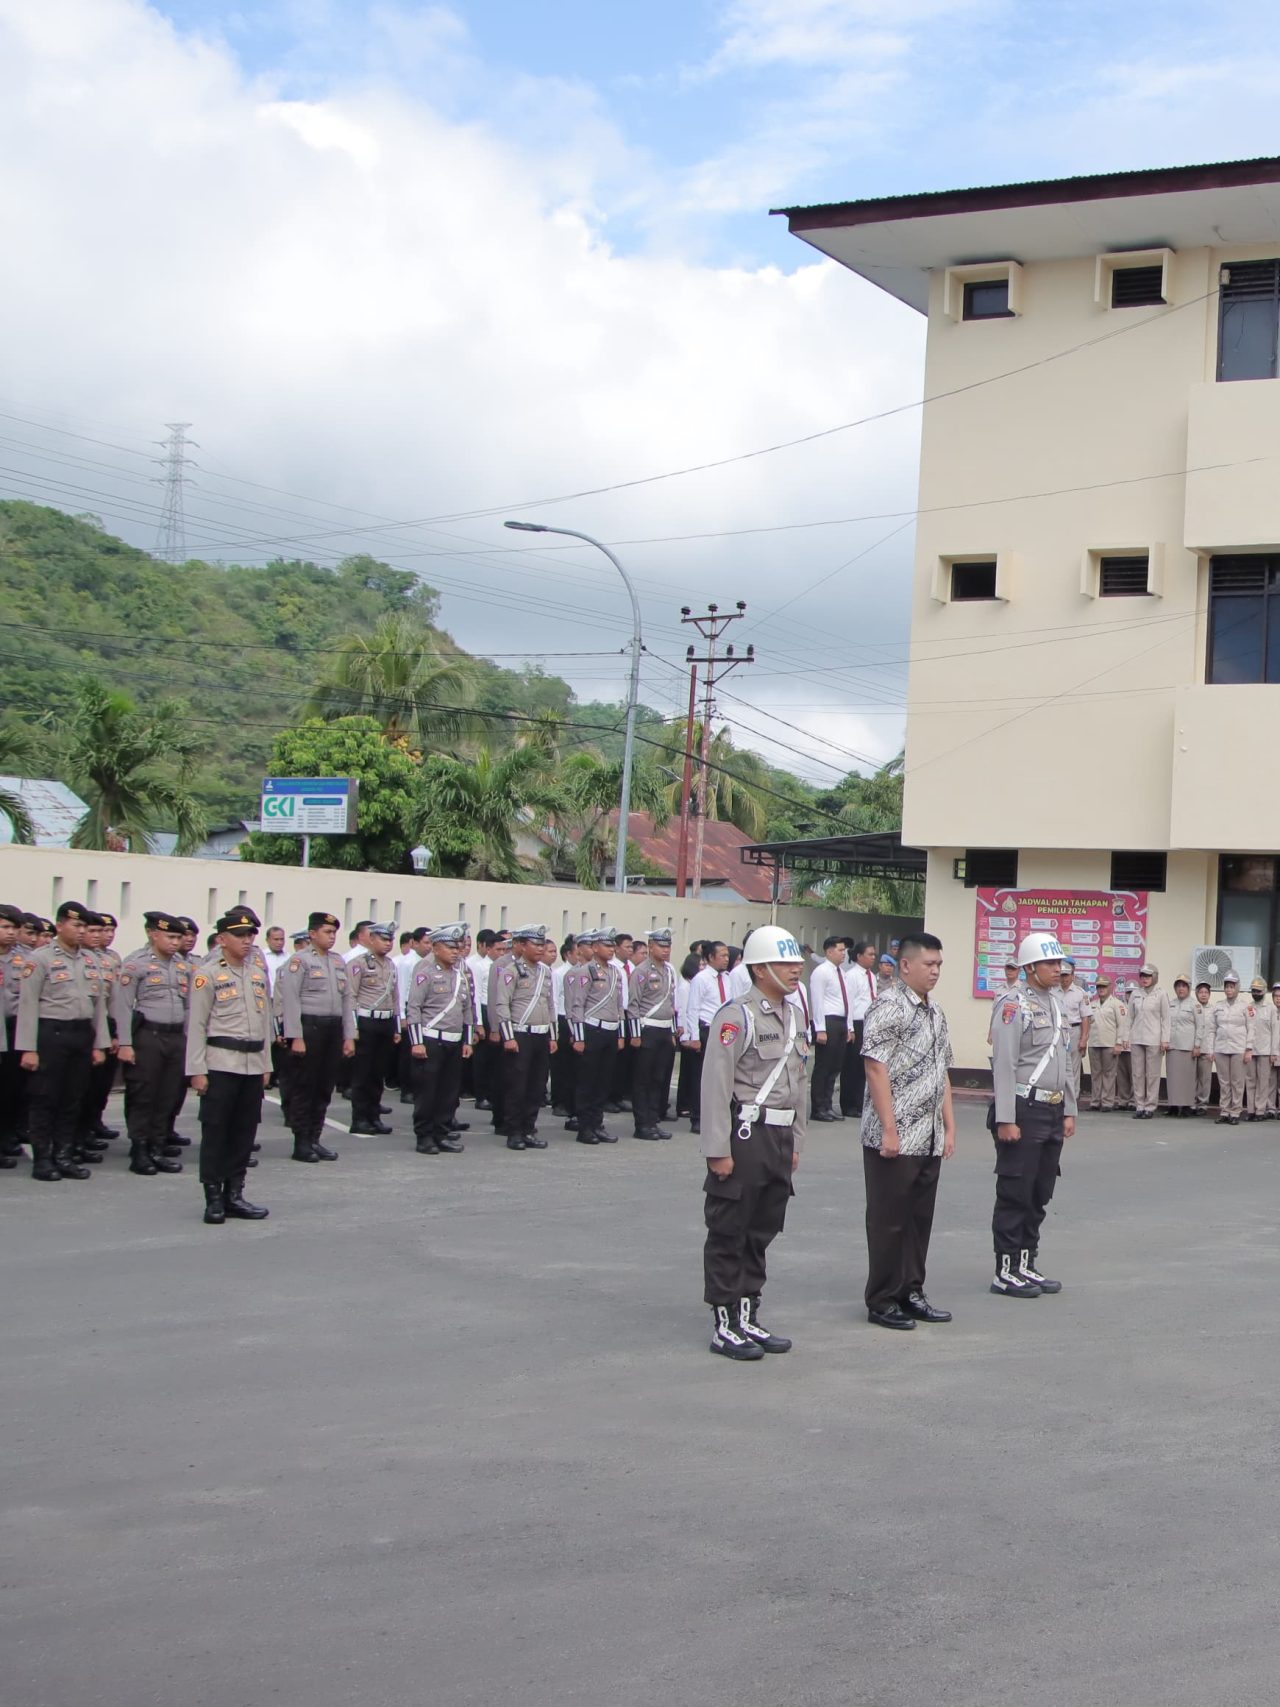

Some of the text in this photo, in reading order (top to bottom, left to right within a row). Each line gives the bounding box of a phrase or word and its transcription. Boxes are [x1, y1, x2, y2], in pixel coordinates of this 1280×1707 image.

[1018, 898, 1109, 908] JADWAL DAN TAHAPAN
[1037, 906, 1087, 915] PEMILU 2024
